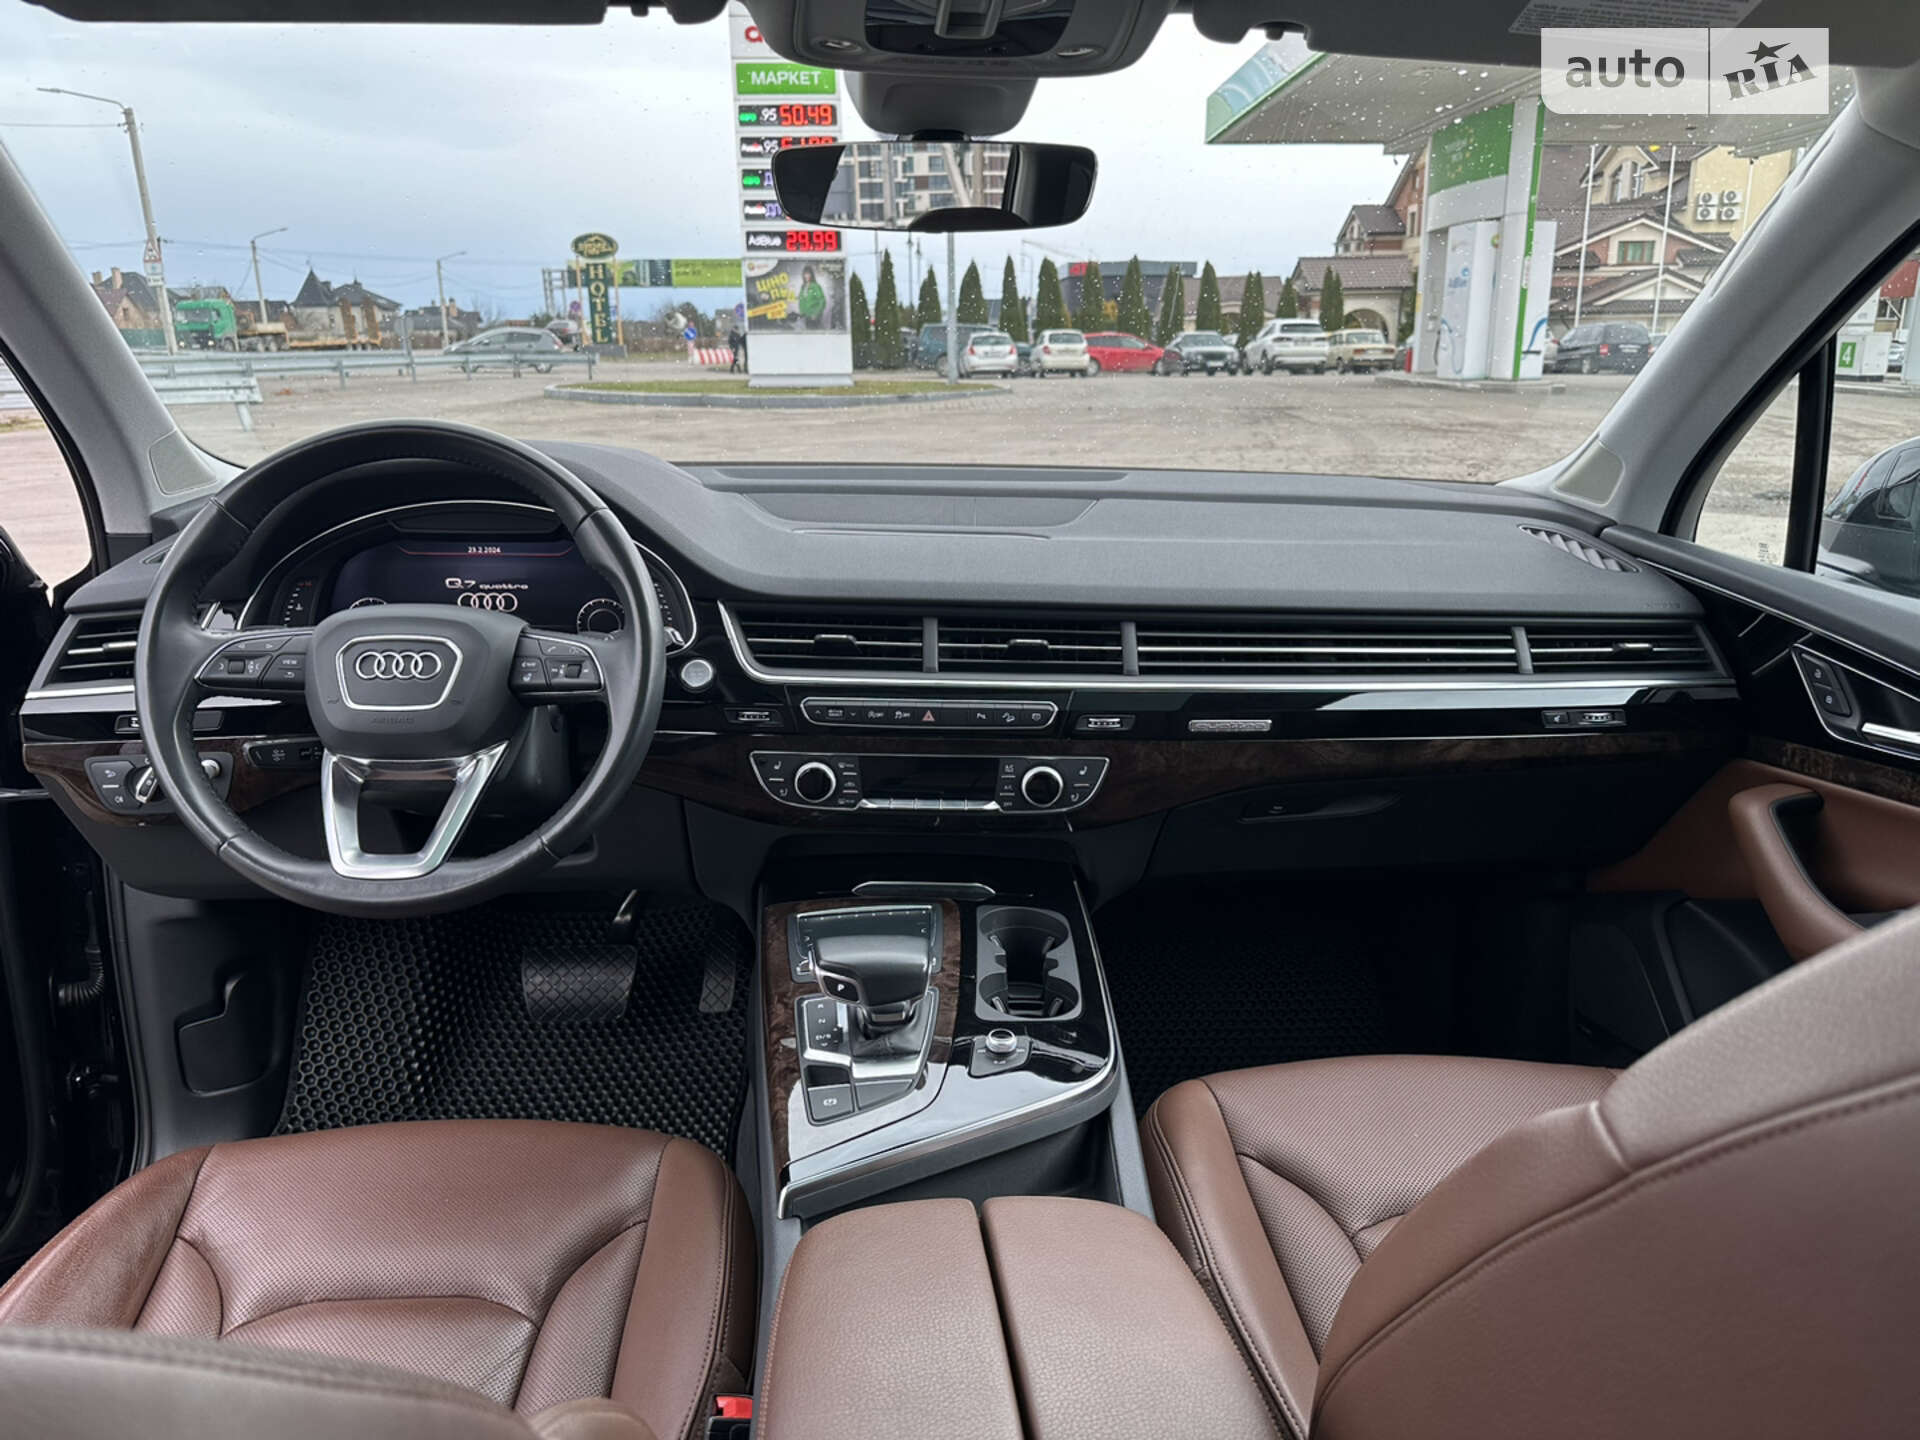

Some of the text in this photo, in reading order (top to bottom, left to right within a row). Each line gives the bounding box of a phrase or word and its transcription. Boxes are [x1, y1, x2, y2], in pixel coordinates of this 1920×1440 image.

[750, 70, 822, 86] МАРКЕТ
[760, 107, 778, 121] 95
[779, 104, 832, 126] 50.49
[763, 139, 779, 153] 95
[785, 230, 838, 252] 29.99
[588, 263, 609, 343] HOTEL
[1842, 344, 1853, 365] 4
[445, 578, 476, 589] Q7
[837, 983, 846, 992] P
